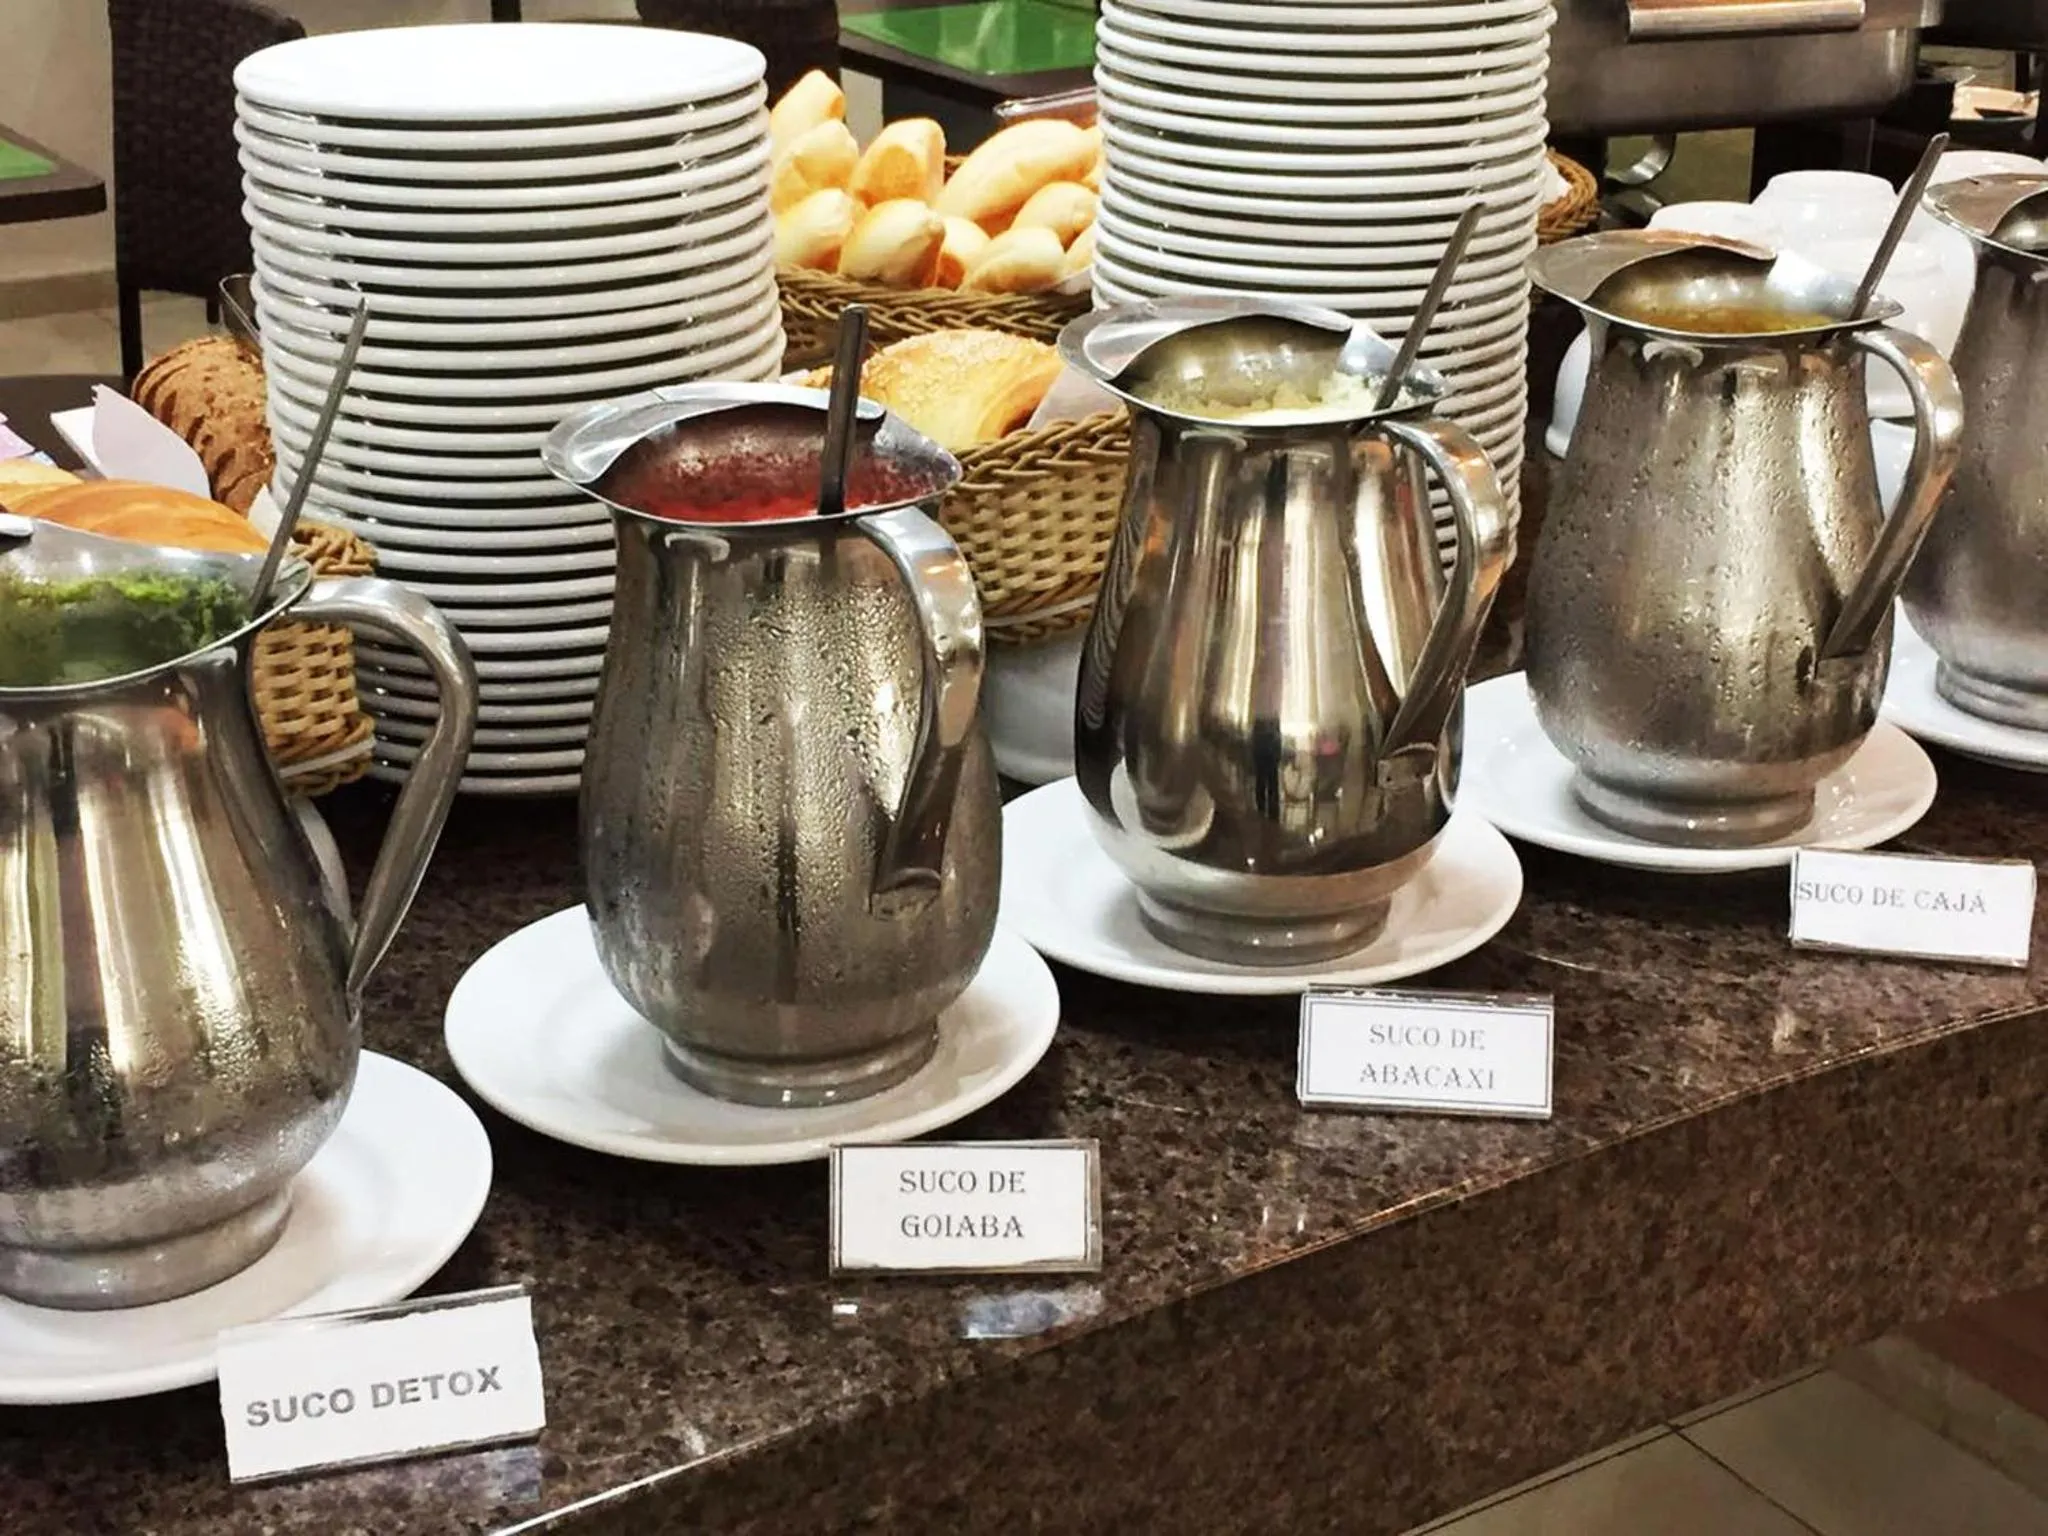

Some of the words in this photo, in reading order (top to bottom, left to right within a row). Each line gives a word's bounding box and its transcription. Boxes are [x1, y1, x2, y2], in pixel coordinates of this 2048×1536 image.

[1797, 881, 1864, 906] SUCO
[1872, 886, 1905, 909] DE
[1369, 1024, 1441, 1048] SUCO
[1450, 1028, 1487, 1051] DE
[1359, 1063, 1495, 1091] ABACAXI
[899, 1170, 978, 1194] SUCO
[988, 1170, 1027, 1194] DE
[900, 1214, 1026, 1239] GOIABA
[246, 1388, 355, 1427] SUCO
[371, 1365, 503, 1409] DETOX
